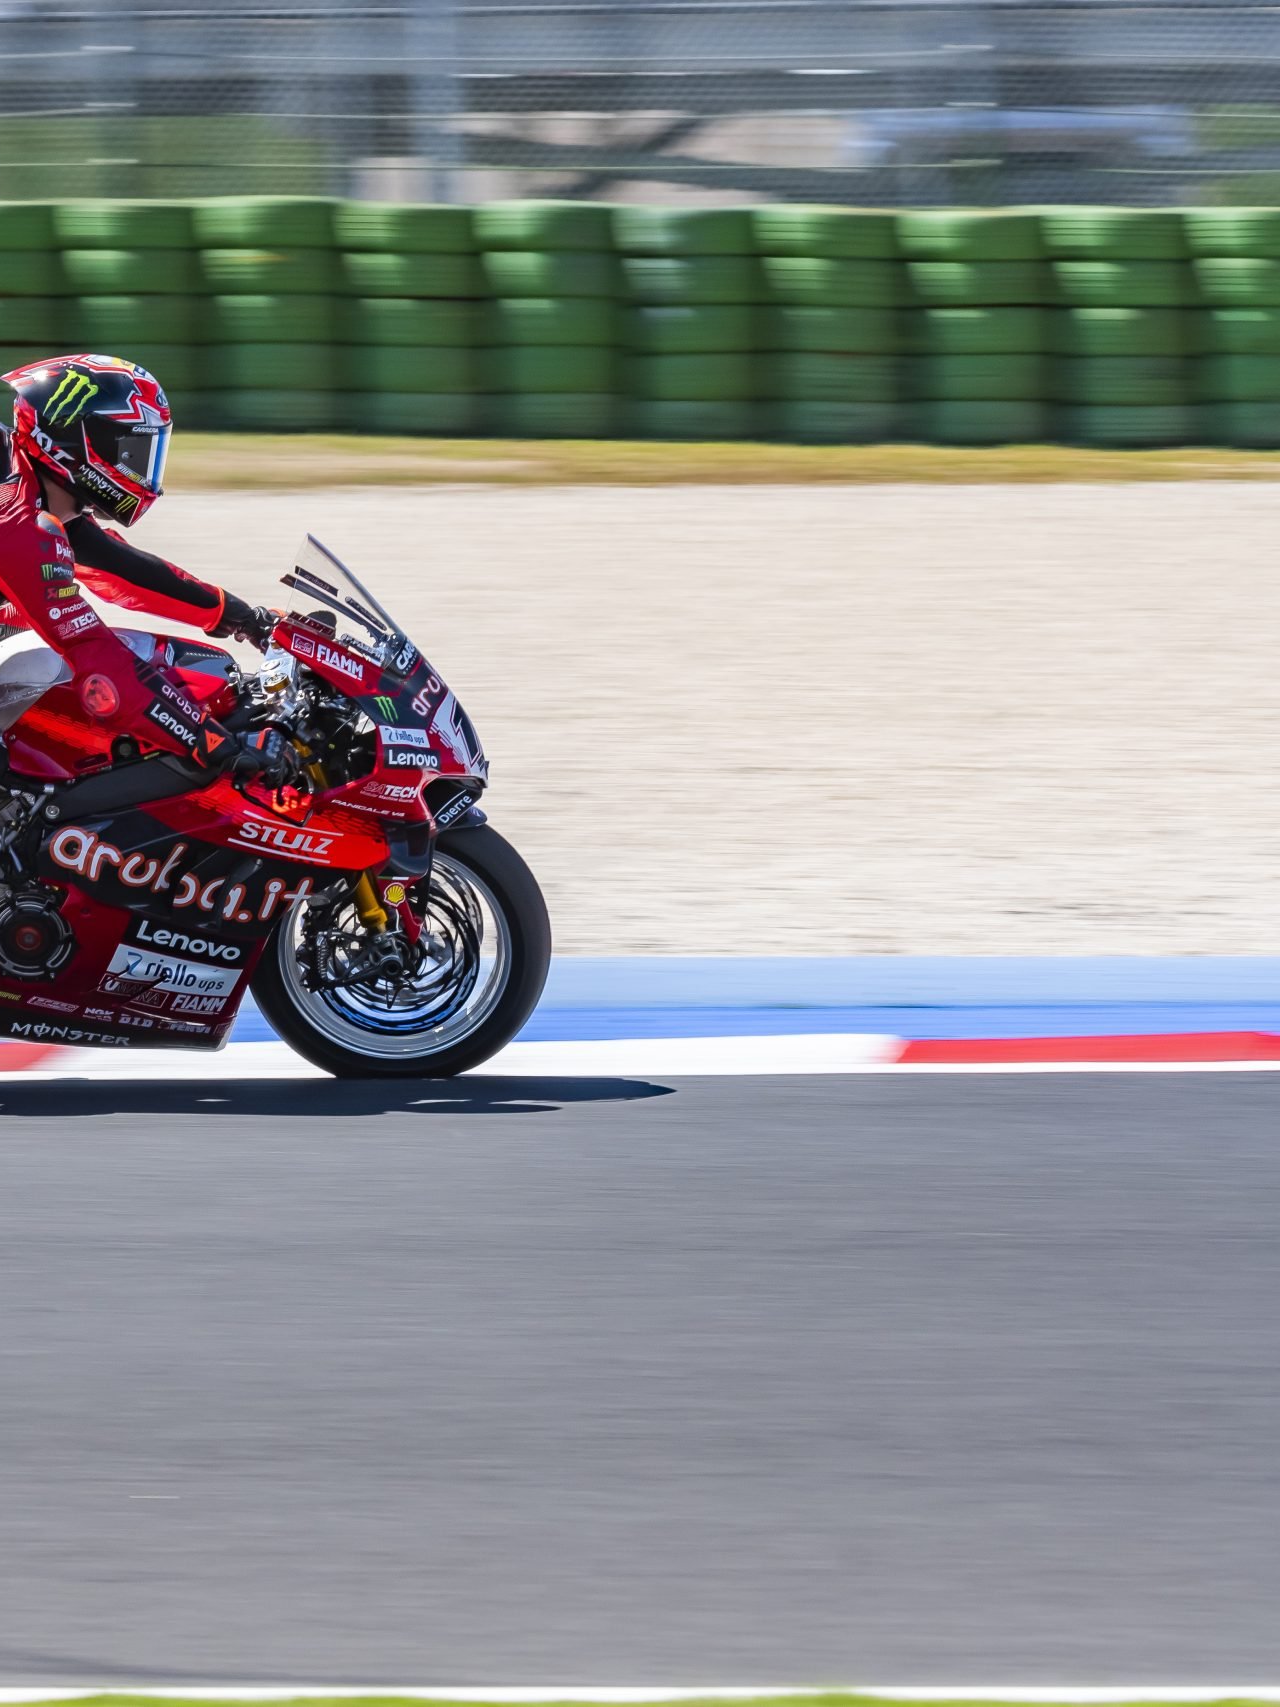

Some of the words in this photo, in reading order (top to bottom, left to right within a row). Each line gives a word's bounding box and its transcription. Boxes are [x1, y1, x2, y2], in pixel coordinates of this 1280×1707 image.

[79, 464, 123, 500] MONSTER
[317, 644, 364, 679] FIAMM
[162, 683, 201, 724] aruba.
[388, 749, 438, 767] Lenovo
[331, 799, 390, 815] PANIGALE
[239, 822, 334, 855] STULZ
[136, 920, 241, 960] Lenovo
[144, 959, 197, 987] riello
[198, 979, 225, 992] ups
[85, 1007, 114, 1017] NGK
[171, 994, 227, 1012] FIAMM
[11, 1022, 130, 1046] MONSTER
